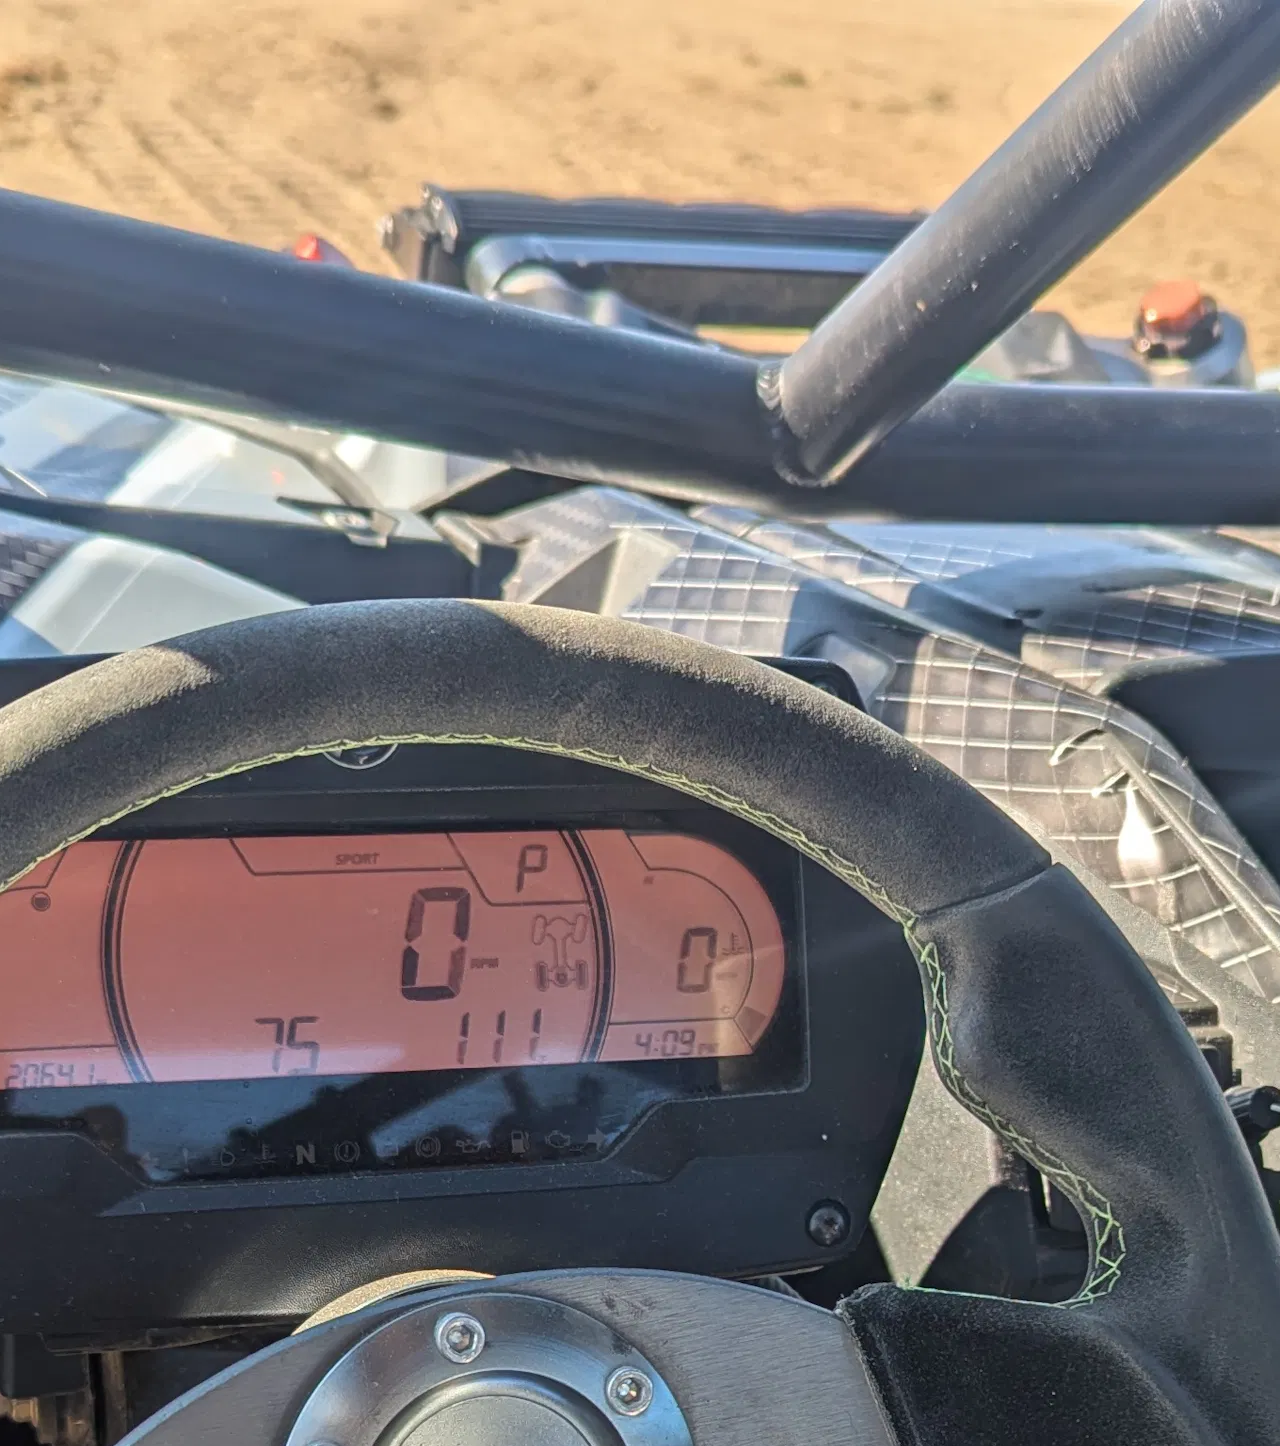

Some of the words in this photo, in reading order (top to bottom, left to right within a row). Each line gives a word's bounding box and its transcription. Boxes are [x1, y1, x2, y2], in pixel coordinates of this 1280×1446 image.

[335, 852, 380, 866] SPORT
[516, 843, 549, 893] P
[401, 886, 470, 1001] 0
[676, 926, 719, 993] 0
[254, 1015, 321, 1076] 75
[635, 1029, 696, 1057] 4:09
[295, 1143, 317, 1175] N
